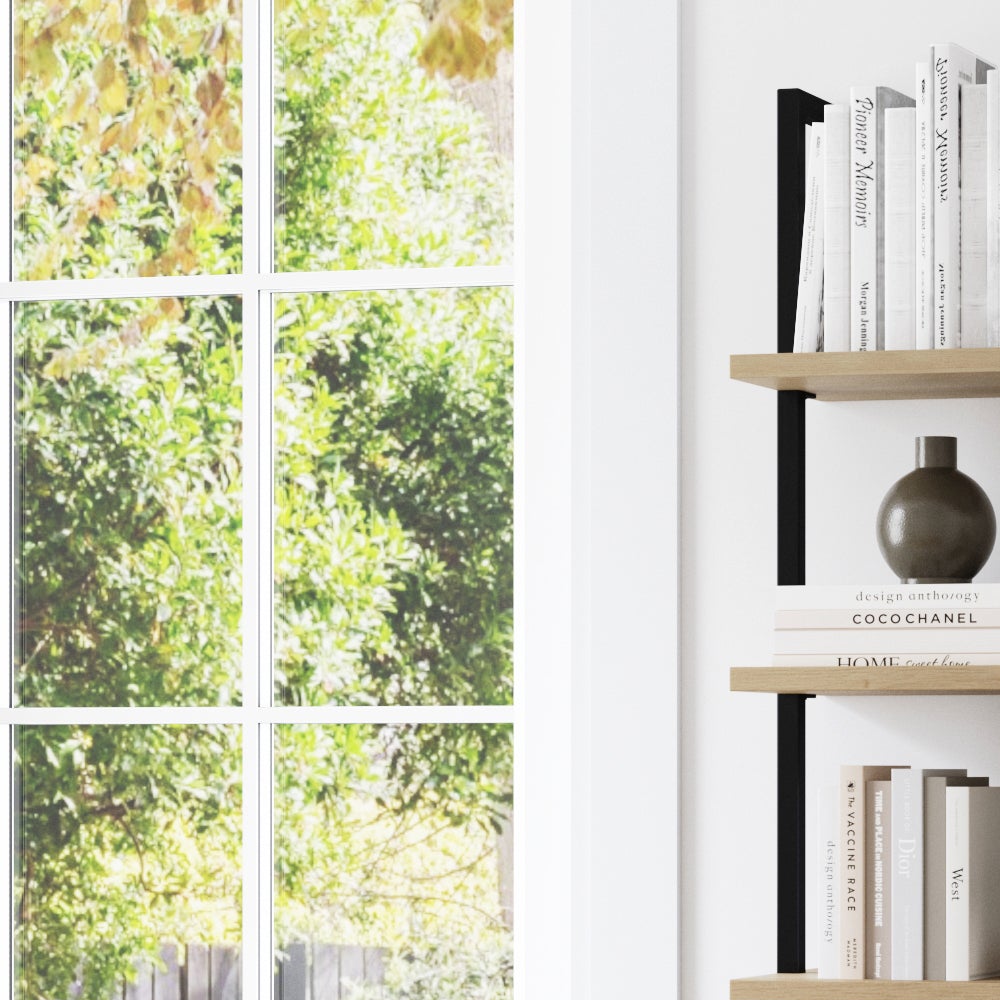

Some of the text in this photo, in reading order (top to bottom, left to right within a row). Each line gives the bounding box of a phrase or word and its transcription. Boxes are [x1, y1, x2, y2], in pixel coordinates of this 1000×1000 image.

[855, 96, 875, 228] Pioneer Memoirs
[859, 281, 870, 351] Morgan Jenning
[856, 590, 904, 603] design
[874, 791, 883, 812] TIME
[846, 811, 855, 871] VACCINE
[874, 826, 883, 852] PLACE
[824, 840, 835, 880] design
[898, 838, 916, 879] Dior
[874, 861, 883, 892] NORDIC
[951, 867, 964, 901] West
[846, 878, 856, 912] RACE
[874, 893, 883, 927] CUISINE
